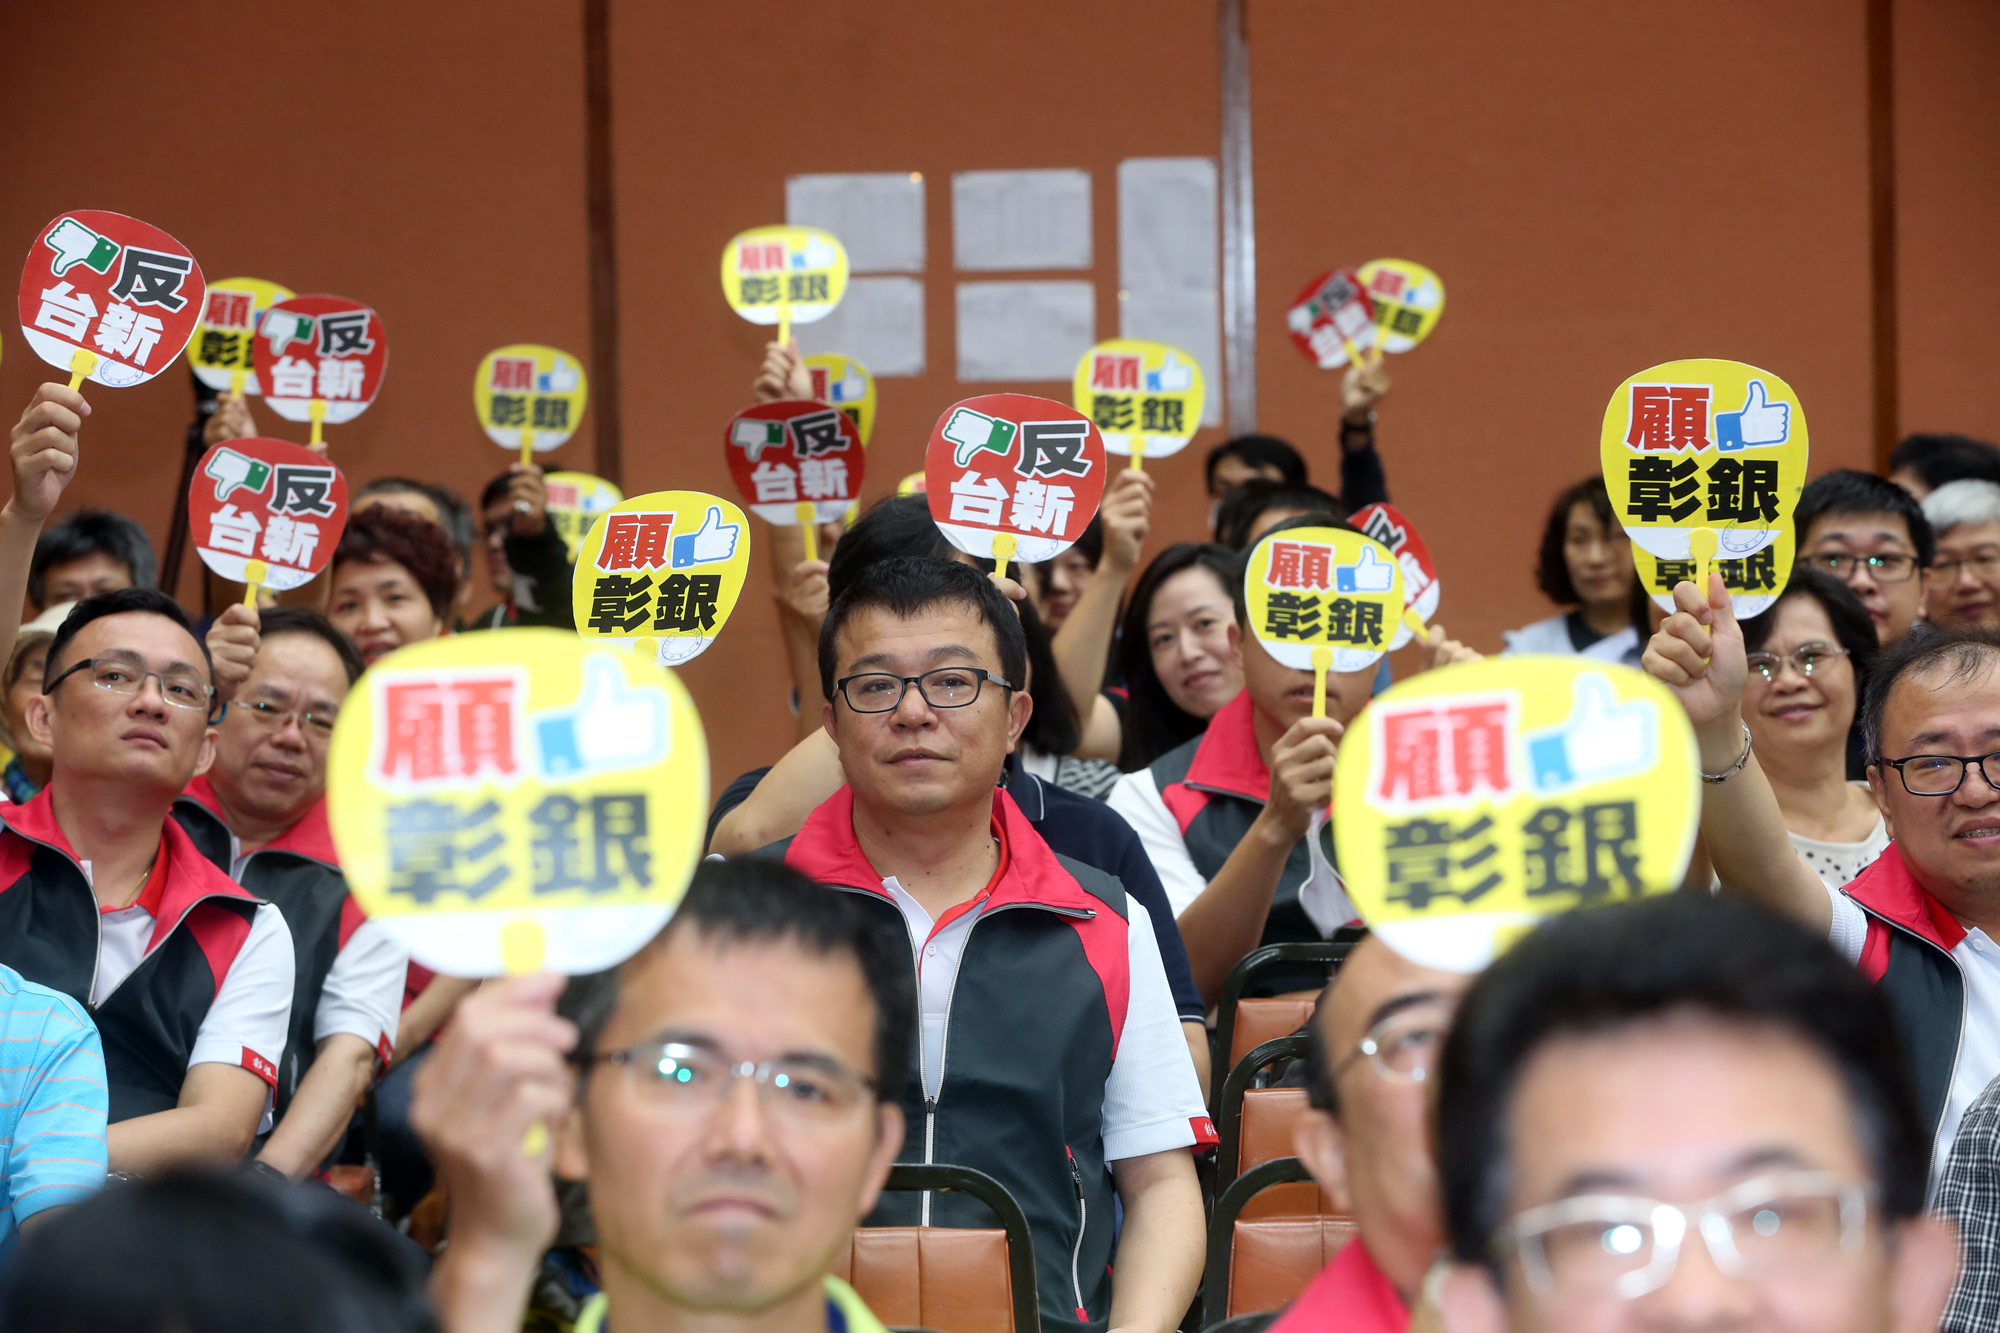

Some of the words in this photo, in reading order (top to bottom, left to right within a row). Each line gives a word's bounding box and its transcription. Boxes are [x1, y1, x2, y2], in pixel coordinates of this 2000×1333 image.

[112, 247, 192, 312] 反
[740, 274, 830, 304] 彰銀
[34, 281, 164, 366] 台新
[200, 331, 256, 366] 彰
[317, 311, 374, 356] 反
[271, 357, 365, 399] 台新
[1091, 354, 1141, 390] 顧
[490, 395, 570, 429] 彰銀
[788, 411, 850, 457] 反
[1092, 395, 1185, 432] 彰銀
[1624, 384, 1714, 453] 顧
[1014, 420, 1092, 478] 反
[267, 465, 337, 518] 反
[751, 458, 848, 501] 台新
[950, 470, 1075, 536] 台新
[1627, 456, 1780, 523] 彰銀
[208, 503, 319, 569] 台新
[595, 512, 677, 572] 顧
[1266, 541, 1333, 592] 顧
[588, 574, 721, 633] 彰銀
[1265, 592, 1383, 647] 彰銀
[380, 676, 520, 781] 顧
[1380, 702, 1511, 802] 顧
[384, 792, 653, 904] 彰銀
[1382, 800, 1645, 909] 彰銀
